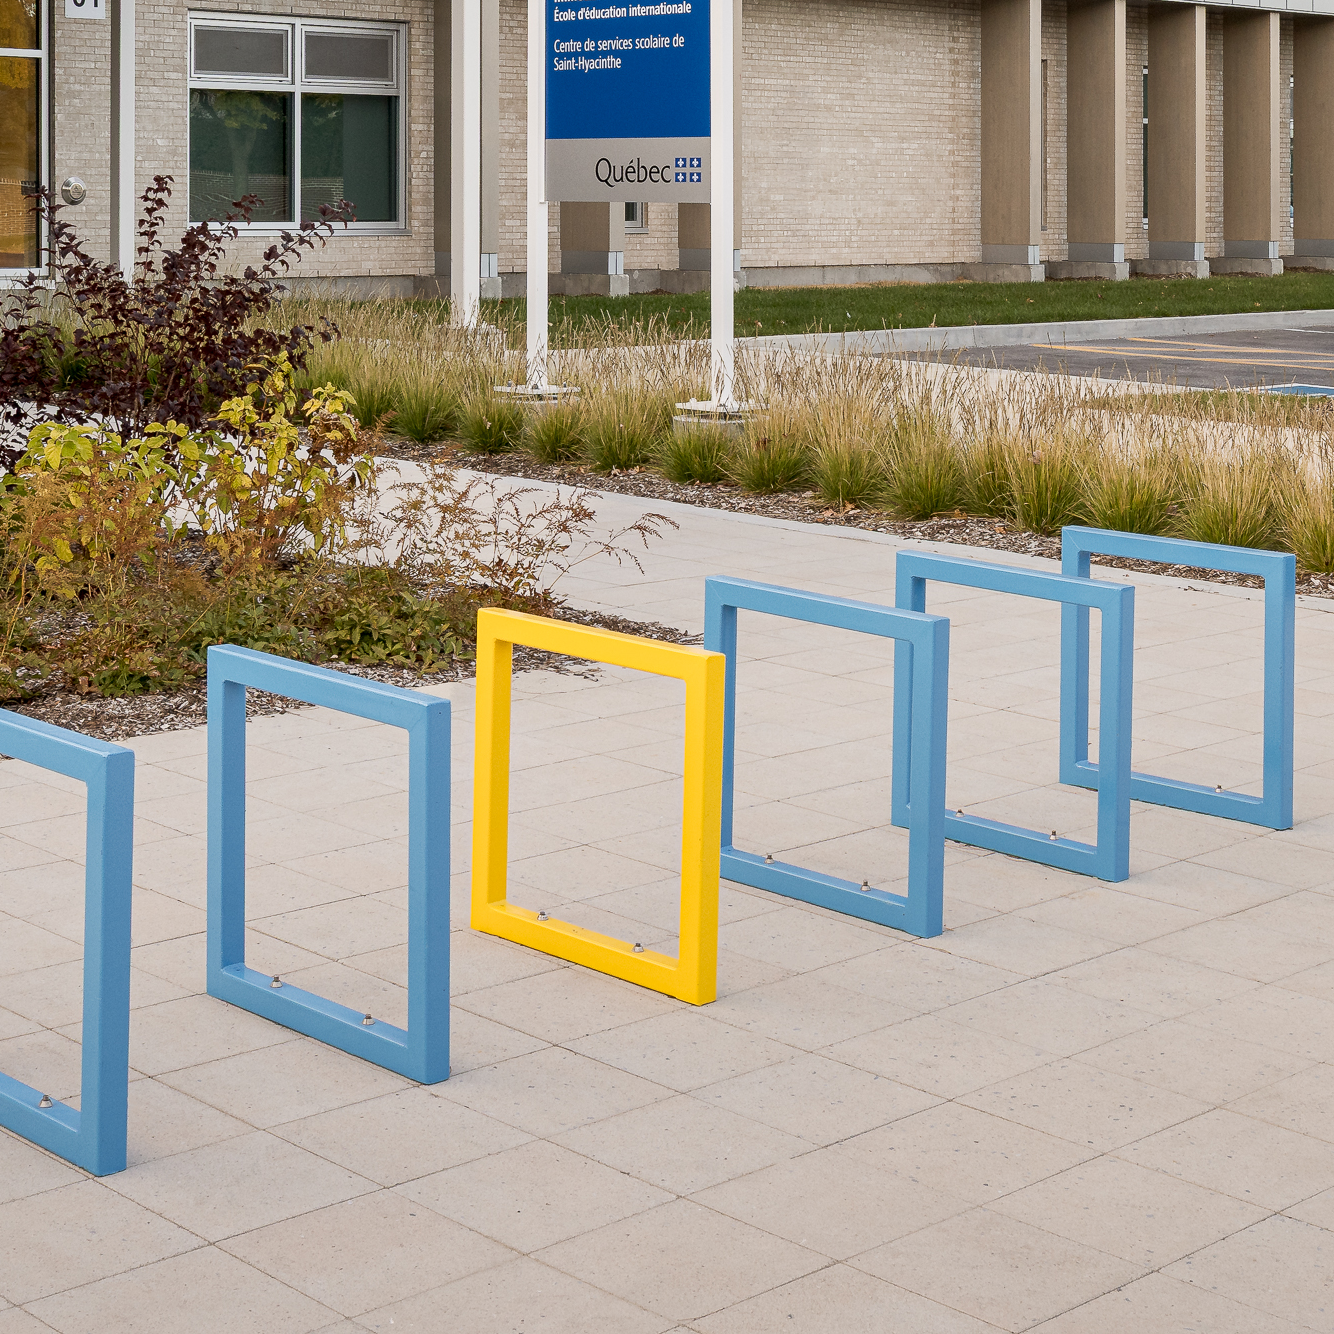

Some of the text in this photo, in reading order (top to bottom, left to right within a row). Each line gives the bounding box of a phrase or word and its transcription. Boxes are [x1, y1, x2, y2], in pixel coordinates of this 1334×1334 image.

[554, 7, 576, 22] École
[629, 1, 692, 17] internationale
[554, 33, 685, 53] Centre de services scolaire de
[554, 55, 622, 73] Saint-Hyacinthe
[596, 158, 671, 188] Québec
